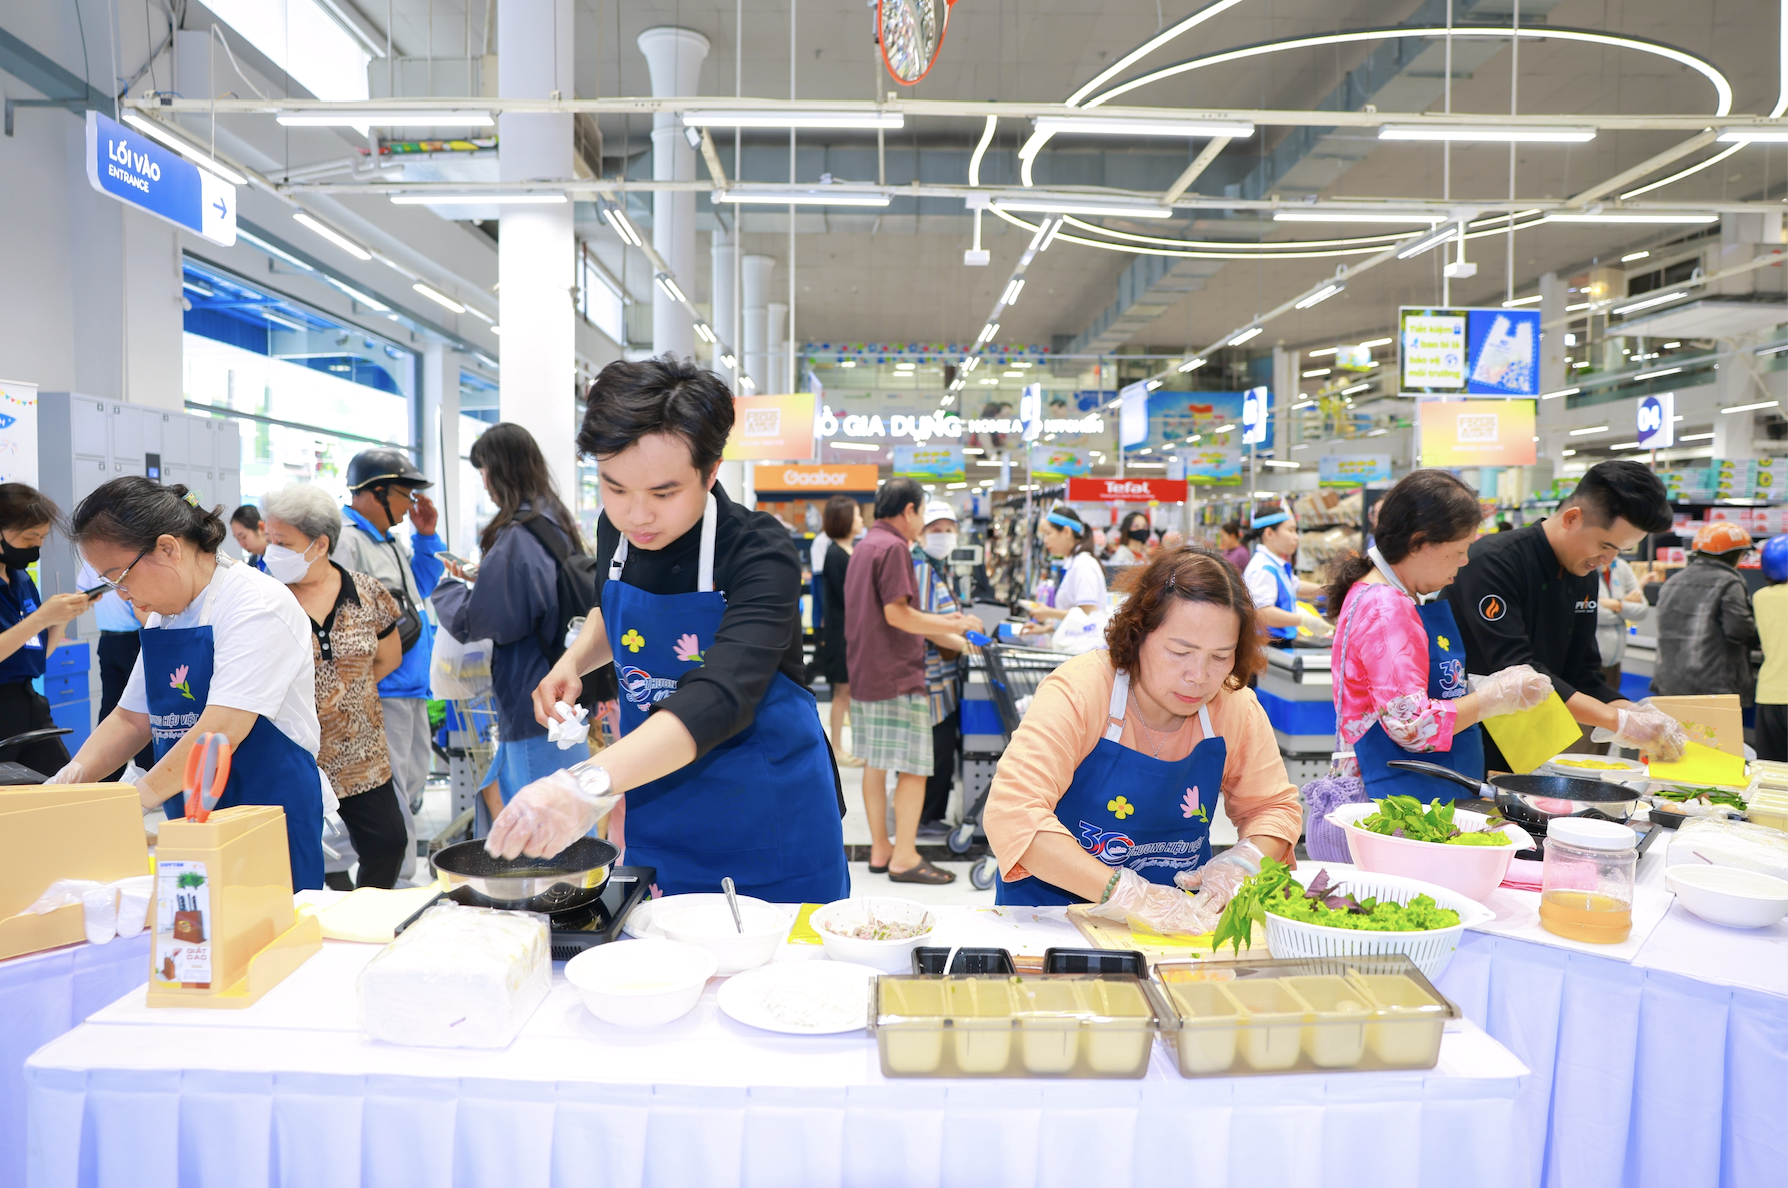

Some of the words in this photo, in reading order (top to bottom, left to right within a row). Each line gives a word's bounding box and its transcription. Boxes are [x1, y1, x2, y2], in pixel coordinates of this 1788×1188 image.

[108, 139, 132, 169] LỐI
[133, 152, 161, 182] VÀO
[108, 163, 150, 193] ENTRANCE
[1429, 324, 1453, 336] kiệm
[1420, 340, 1438, 349] bao
[815, 405, 839, 437] Ồ
[843, 414, 887, 438] GIA
[968, 418, 1012, 434] HOME
[1012, 418, 1044, 434] AD
[1638, 405, 1660, 432] 04
[783, 469, 847, 486] Gaabor
[1104, 481, 1151, 494] Tefal
